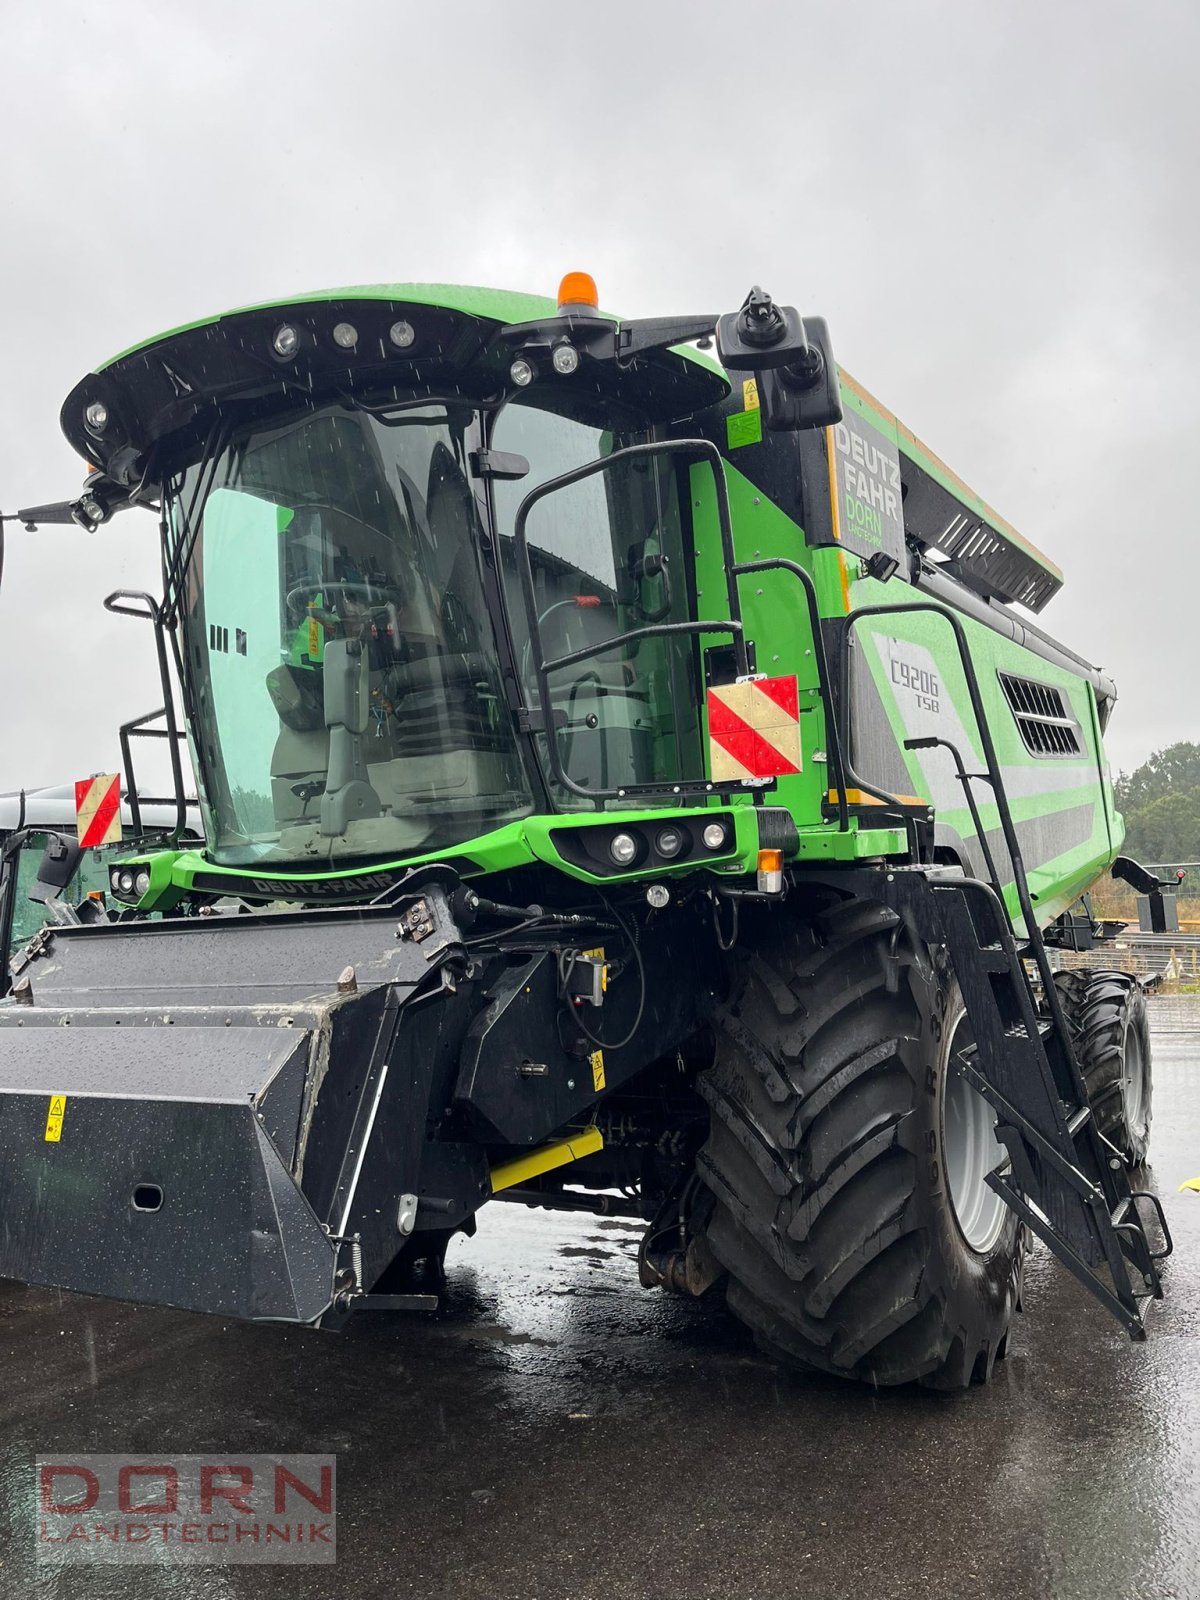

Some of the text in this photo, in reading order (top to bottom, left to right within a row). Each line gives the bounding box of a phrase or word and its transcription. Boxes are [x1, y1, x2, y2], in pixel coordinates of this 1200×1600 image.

[834, 424, 901, 491] DEUTZ
[843, 461, 898, 521] FAHR
[846, 494, 881, 537] DORN
[891, 659, 938, 697] C9206
[915, 694, 939, 713] TSB
[252, 873, 395, 895] DEUTZ-FAHR
